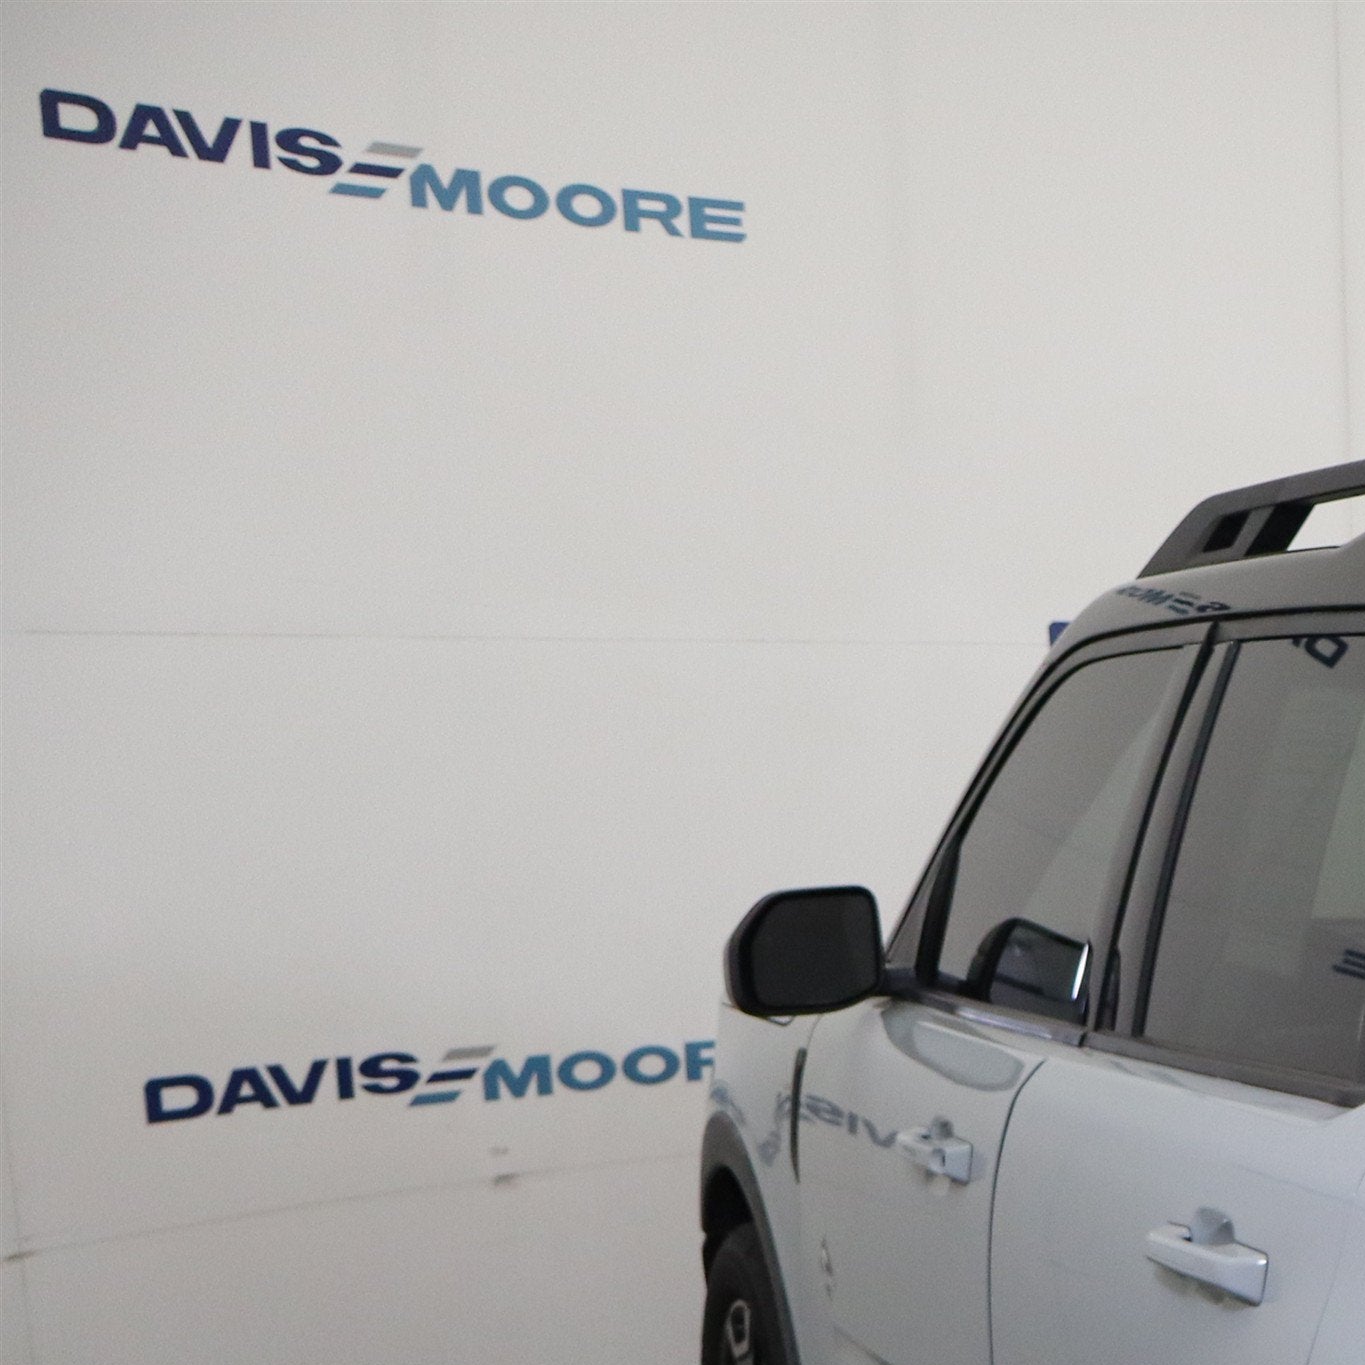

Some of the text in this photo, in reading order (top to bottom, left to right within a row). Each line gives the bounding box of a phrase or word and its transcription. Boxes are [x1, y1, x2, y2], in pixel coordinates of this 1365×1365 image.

[37, 87, 747, 243] DAVIS MOORE
[142, 1040, 716, 1126] DAVIS MOOR
